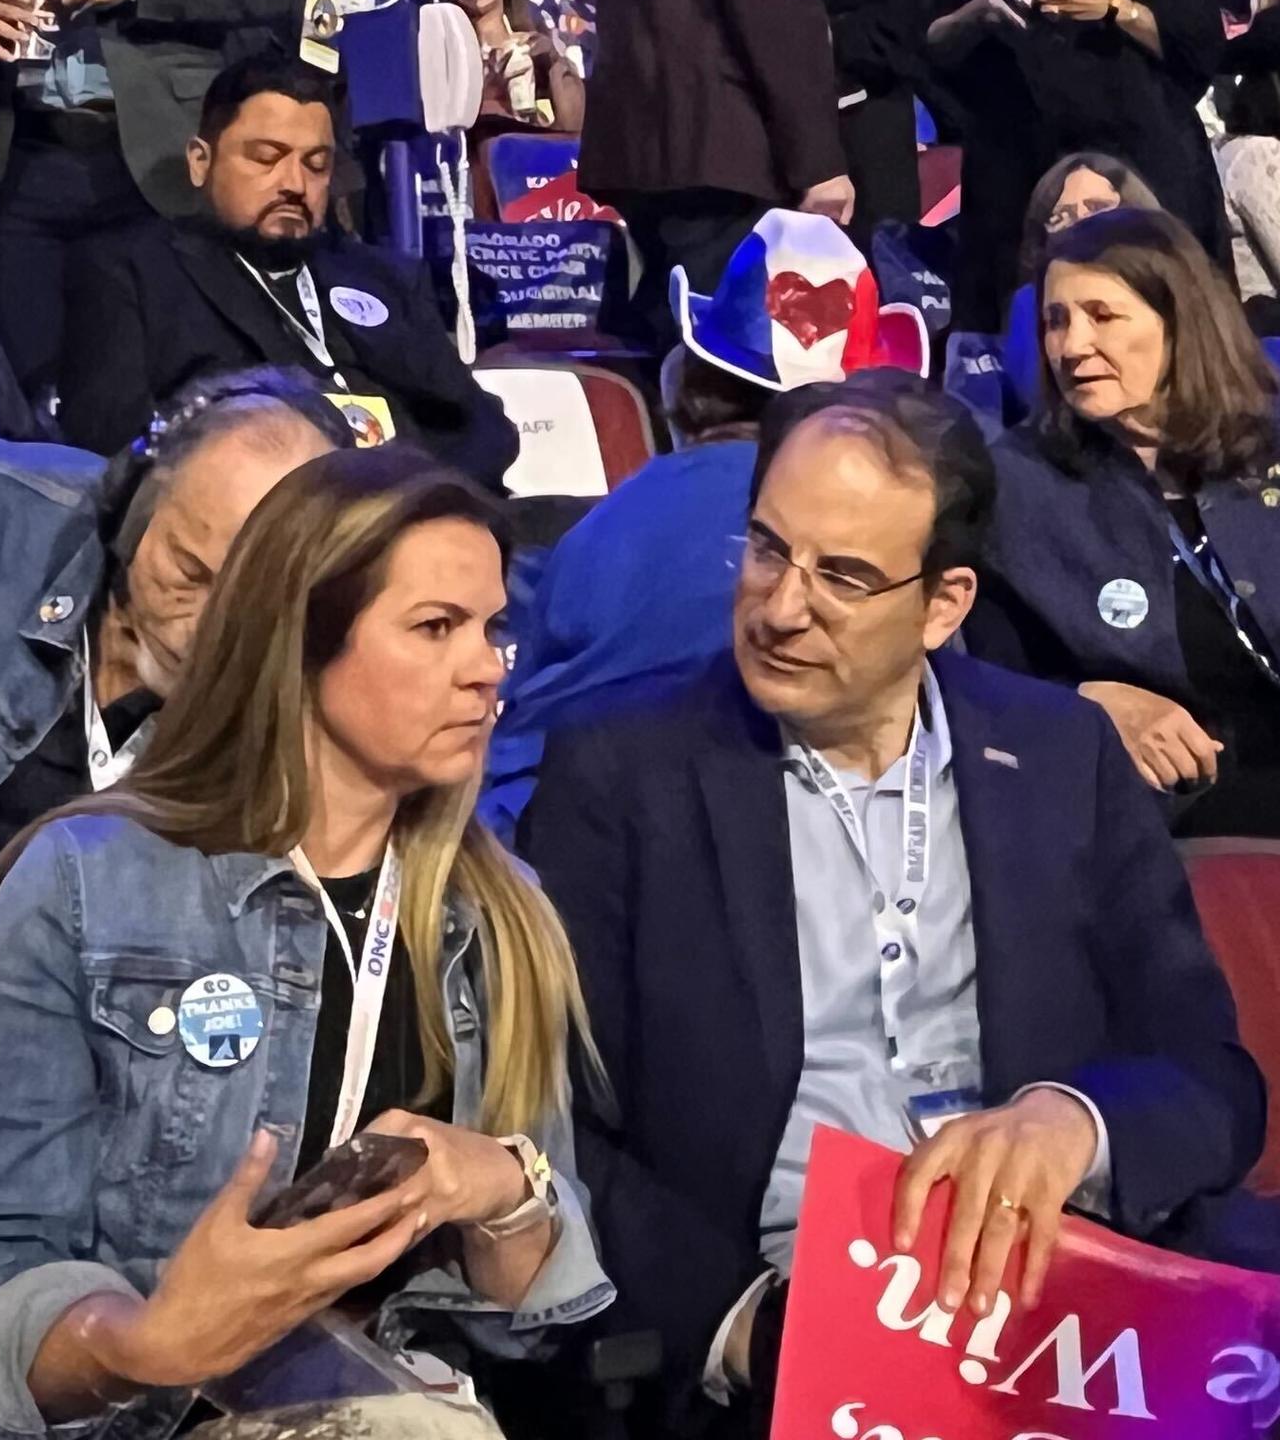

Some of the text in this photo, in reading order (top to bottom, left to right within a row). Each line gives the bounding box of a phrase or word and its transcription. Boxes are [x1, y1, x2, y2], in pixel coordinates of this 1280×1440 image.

[520, 420, 554, 434] AFF
[368, 920, 390, 977] DNC
[204, 979, 231, 994] CO
[848, 1239, 1158, 1420] Win.
